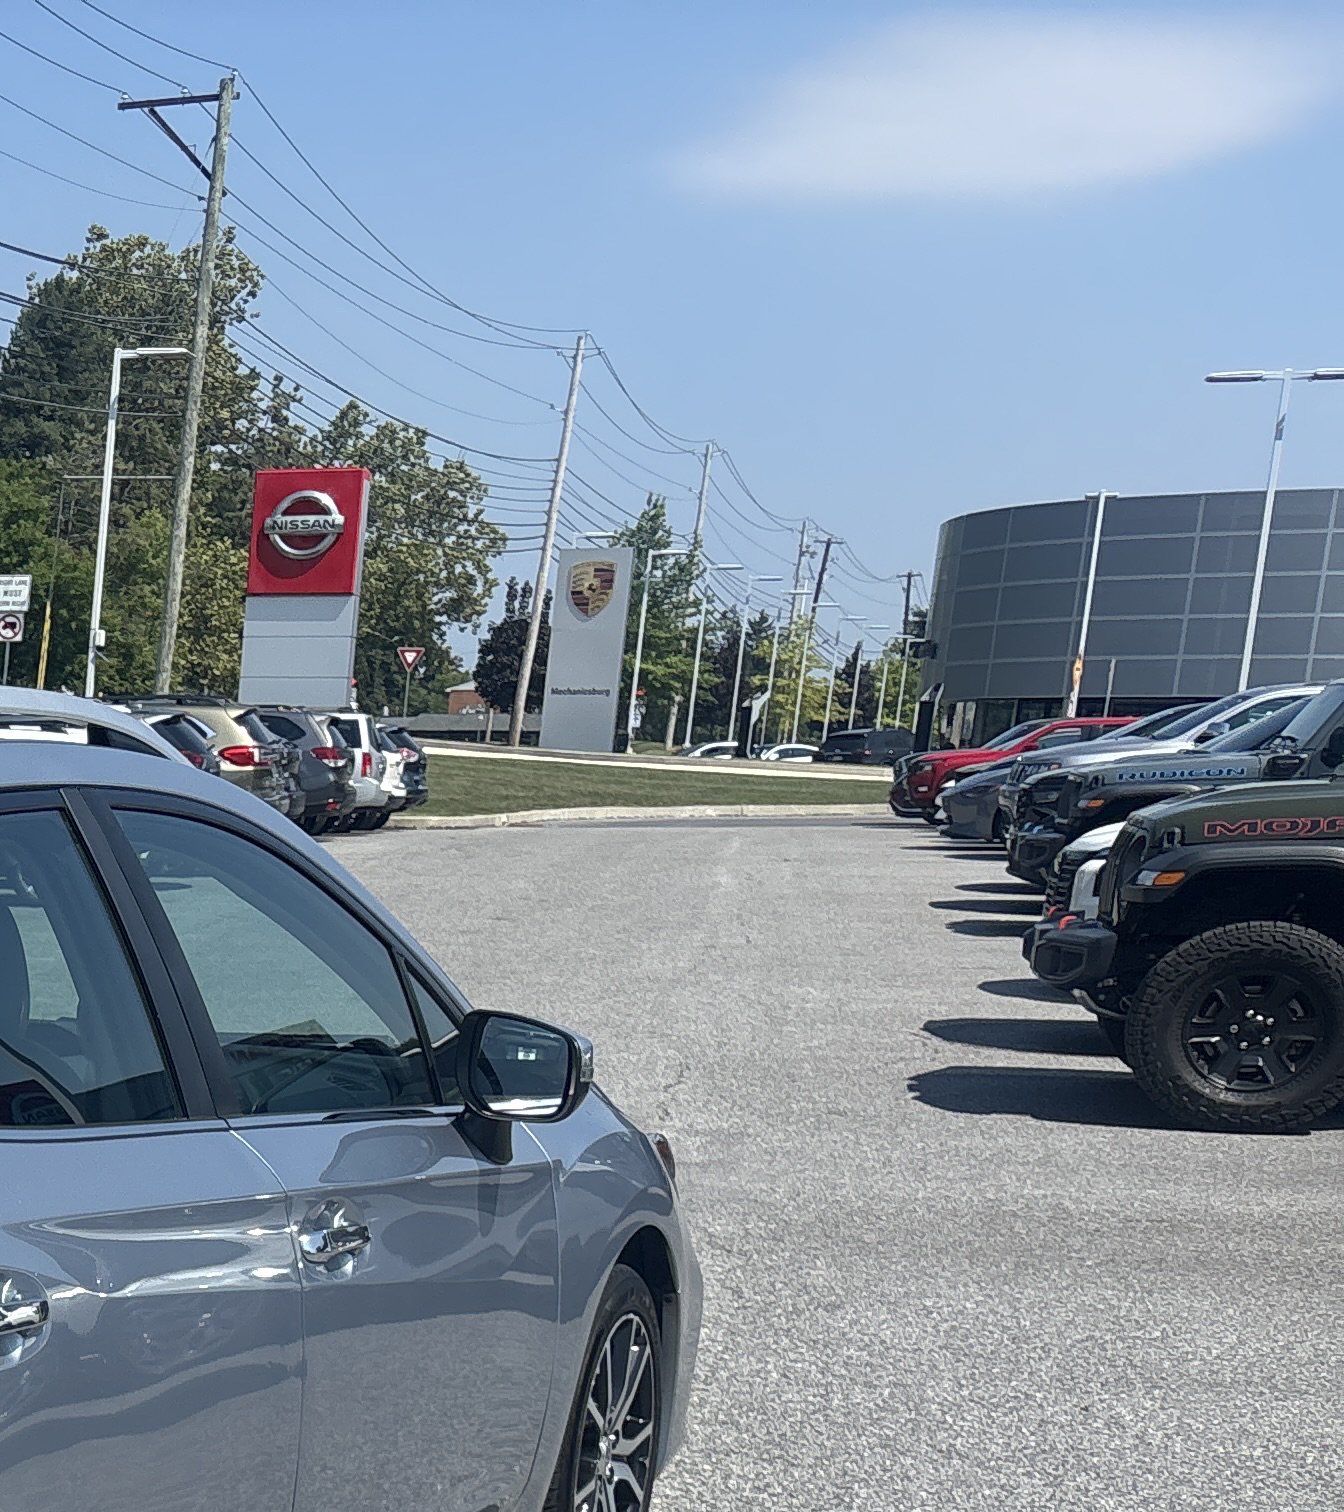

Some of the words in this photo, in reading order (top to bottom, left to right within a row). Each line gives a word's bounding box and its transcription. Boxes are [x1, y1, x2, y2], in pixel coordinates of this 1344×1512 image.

[271, 519, 336, 531] NISSAN
[551, 687, 610, 697] Mechanicsburg
[1117, 767, 1247, 781] RUBICON
